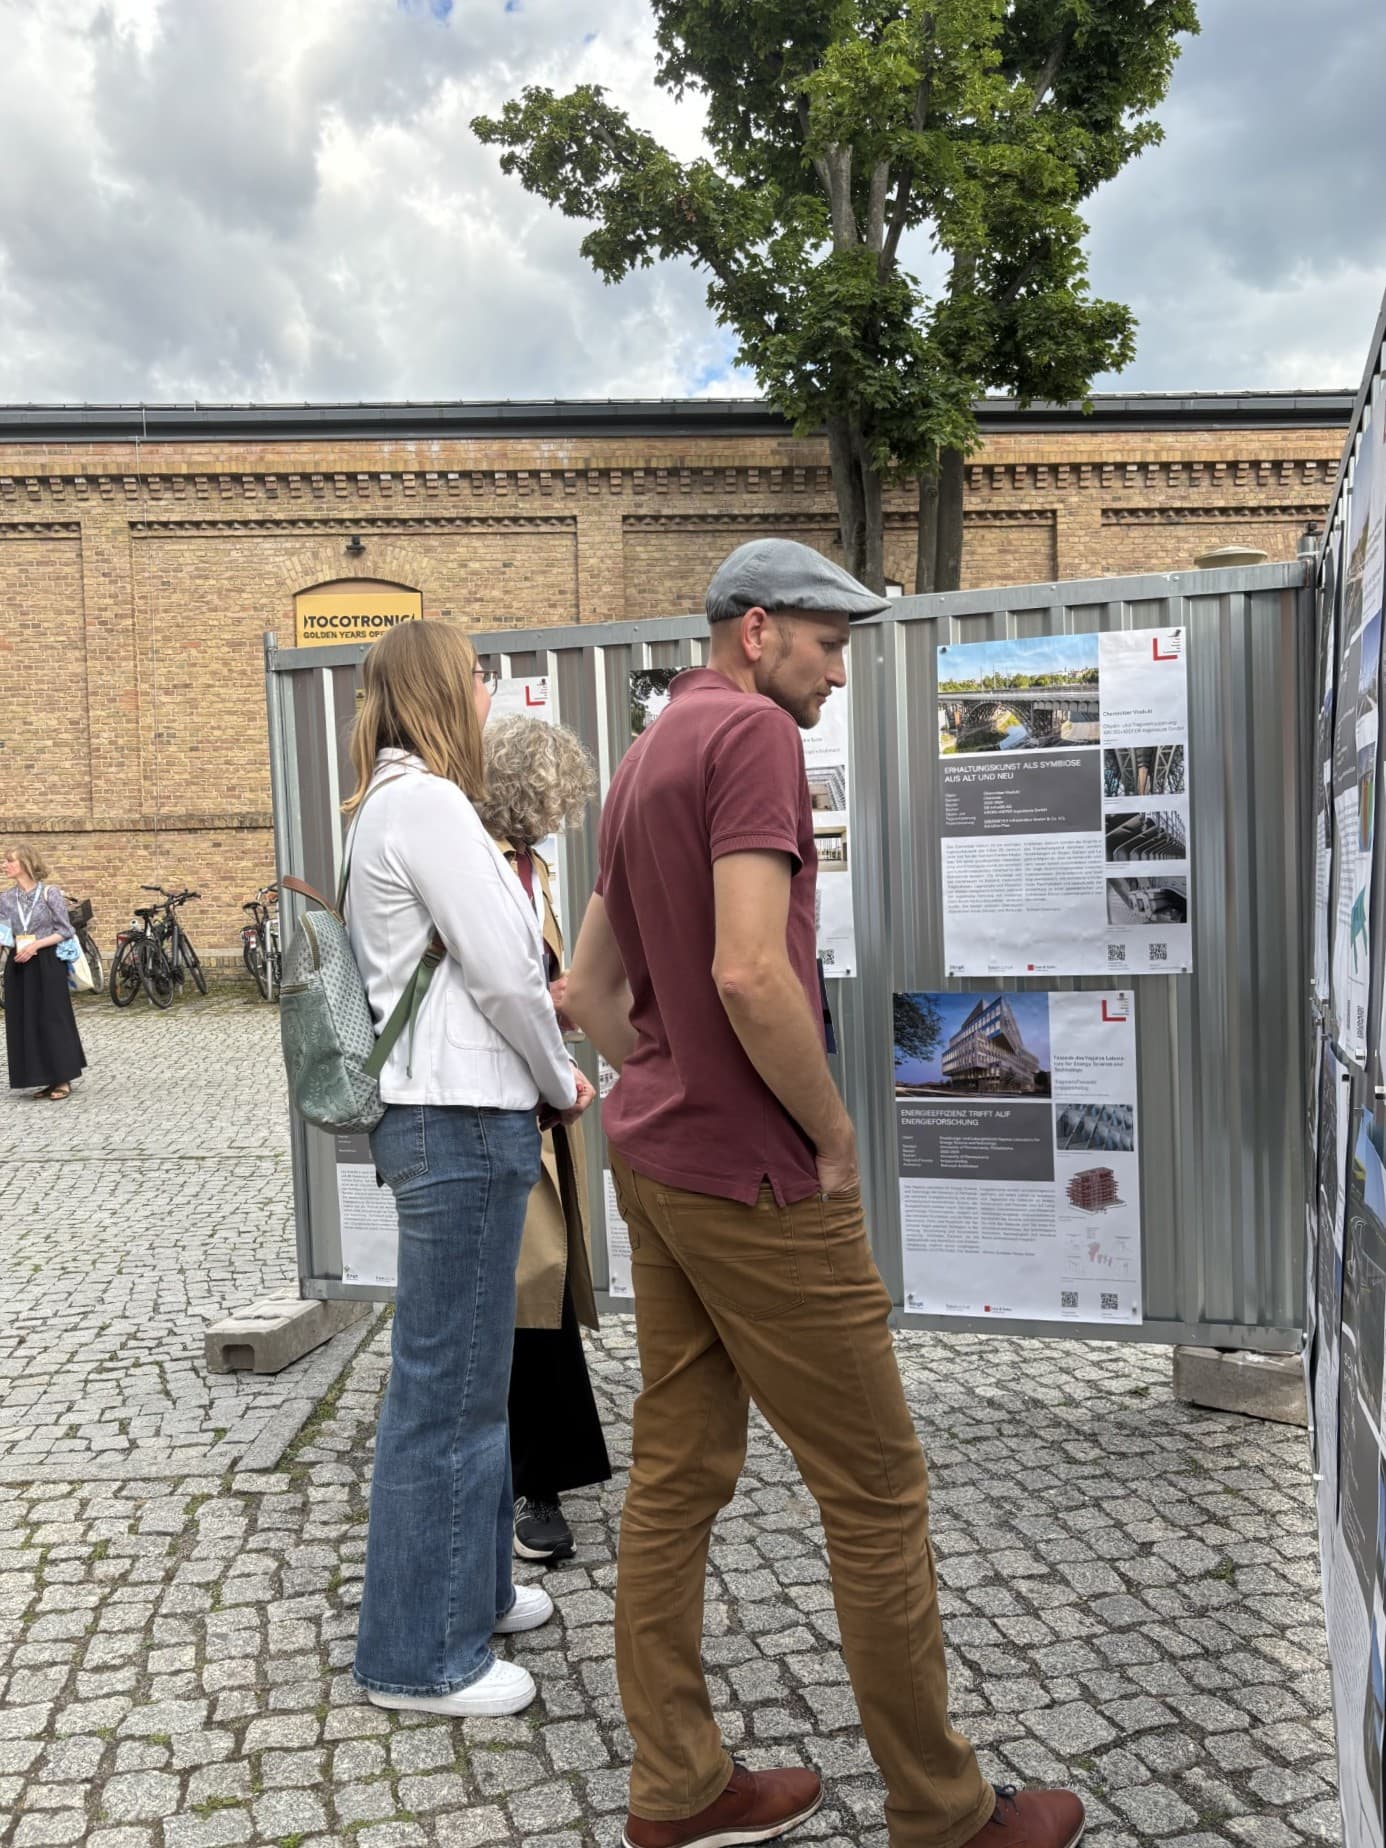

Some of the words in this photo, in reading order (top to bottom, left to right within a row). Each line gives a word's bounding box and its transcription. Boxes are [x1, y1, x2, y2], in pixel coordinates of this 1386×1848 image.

[303, 631, 337, 639] GOLDEN
[339, 630, 367, 639] YEARS
[944, 763, 1021, 775] ERHALTUNGSKUNST
[1023, 761, 1039, 769] ALS
[1039, 759, 1081, 769] SYMBIOSE
[944, 775, 961, 783] AUS
[962, 774, 977, 782] ALT
[978, 773, 996, 781] UND
[997, 772, 1014, 780] NEU
[968, 1110, 993, 1118] TRIFFT
[994, 1110, 1012, 1118] AUF
[901, 1118, 980, 1126] ENERGIEFORSCHUNG
